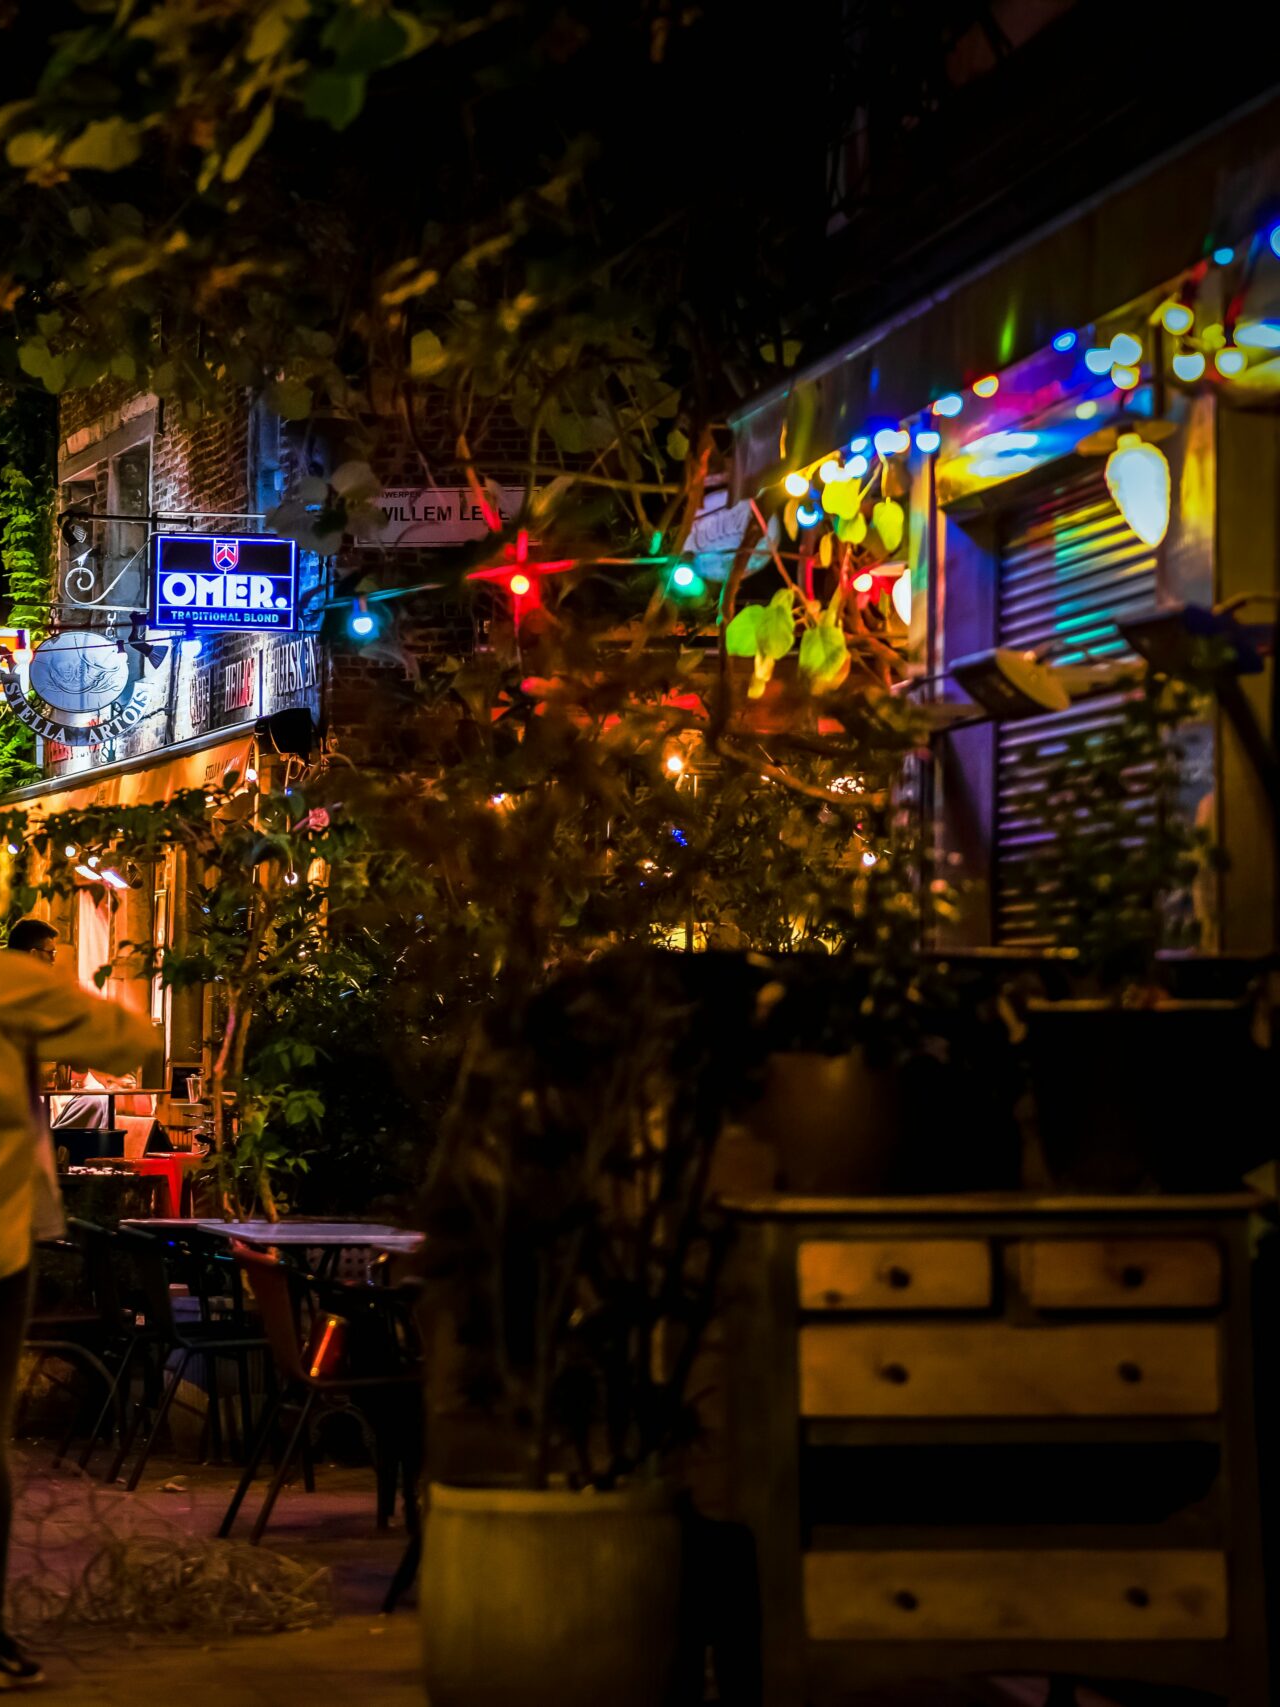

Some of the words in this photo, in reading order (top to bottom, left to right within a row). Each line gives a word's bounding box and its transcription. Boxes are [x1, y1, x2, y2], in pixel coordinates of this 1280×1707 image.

[162, 573, 288, 609] OMER.
[170, 610, 241, 622] TRADITIONAL
[243, 612, 279, 623] BLOND
[5, 682, 66, 746] STELLA
[88, 691, 148, 745] ARTOIS
